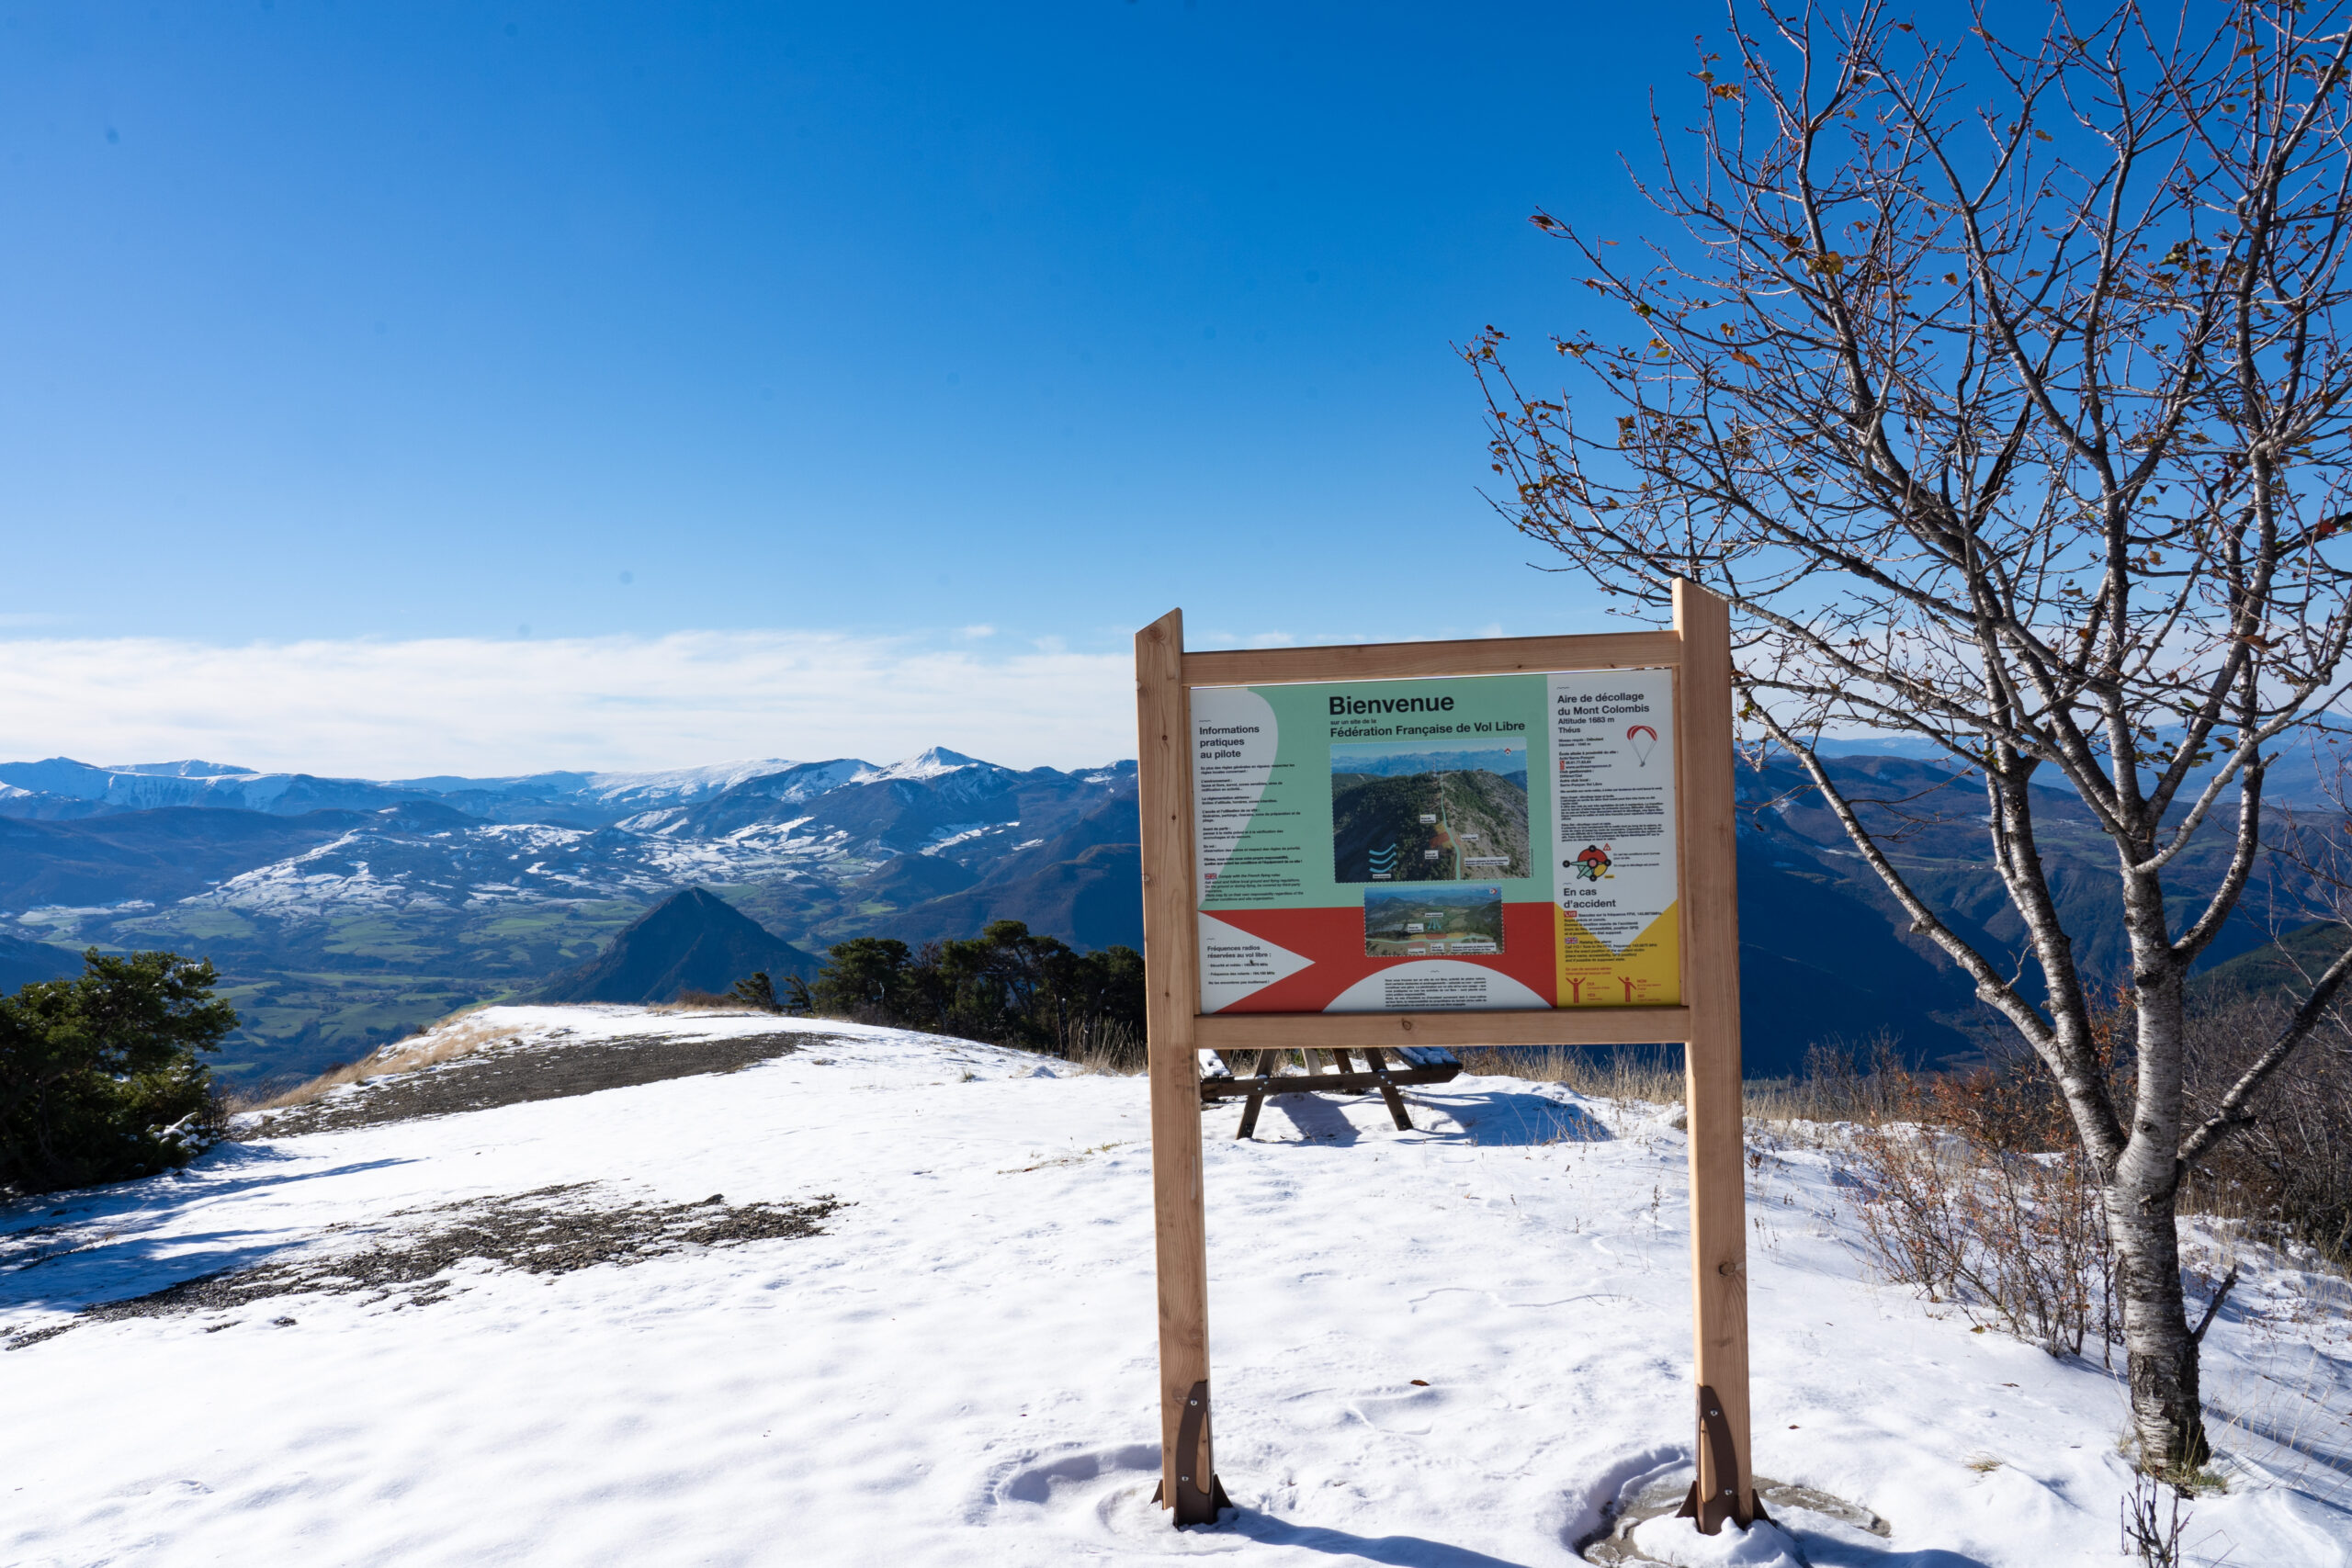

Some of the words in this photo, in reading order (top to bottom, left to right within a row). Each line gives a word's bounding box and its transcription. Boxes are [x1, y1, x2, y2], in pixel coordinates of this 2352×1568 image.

[1557, 694, 1577, 704] Aire
[1580, 694, 1593, 703] de
[1595, 693, 1645, 702] décollage
[1329, 695, 1454, 715] Bienvenue
[1558, 707, 1570, 716] du
[1574, 706, 1600, 715] Mont
[1601, 705, 1649, 714] Colombis
[1199, 726, 1260, 735] Informations
[1330, 725, 1392, 738] Fédération
[1396, 723, 1453, 737] Française
[1456, 723, 1470, 733] de
[1474, 722, 1492, 732] Vol
[1496, 720, 1525, 731] Libre
[1200, 739, 1245, 748] pratiques
[1215, 750, 1241, 760] pilote
[1564, 887, 1577, 897] En
[1564, 899, 1616, 908] d'accident
